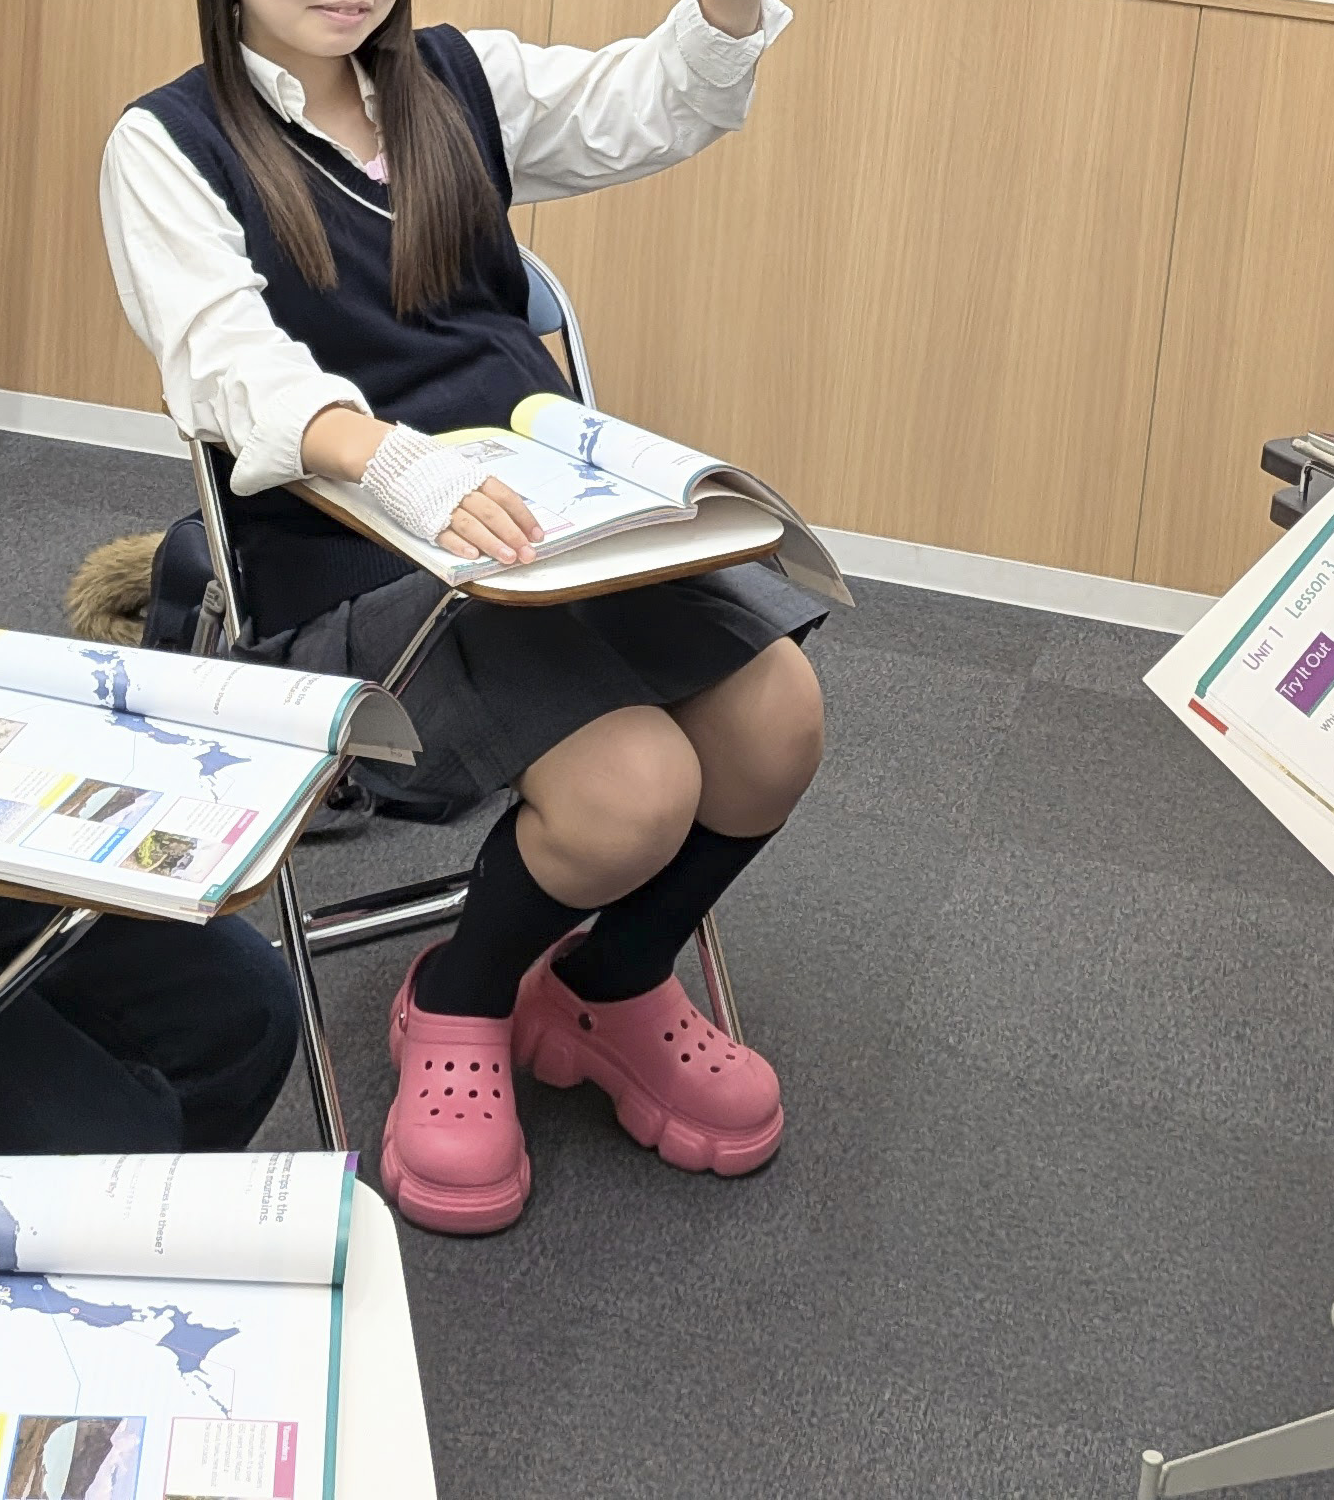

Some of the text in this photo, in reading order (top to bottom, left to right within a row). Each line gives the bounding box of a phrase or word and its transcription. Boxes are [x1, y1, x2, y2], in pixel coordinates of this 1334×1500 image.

[1269, 626, 1283, 638] 1
[1285, 573, 1330, 619] Lesson
[1280, 639, 1333, 697] Try It Out
[275, 1203, 287, 1222] the
[278, 1191, 288, 1201] to
[154, 1219, 166, 1254] these?
